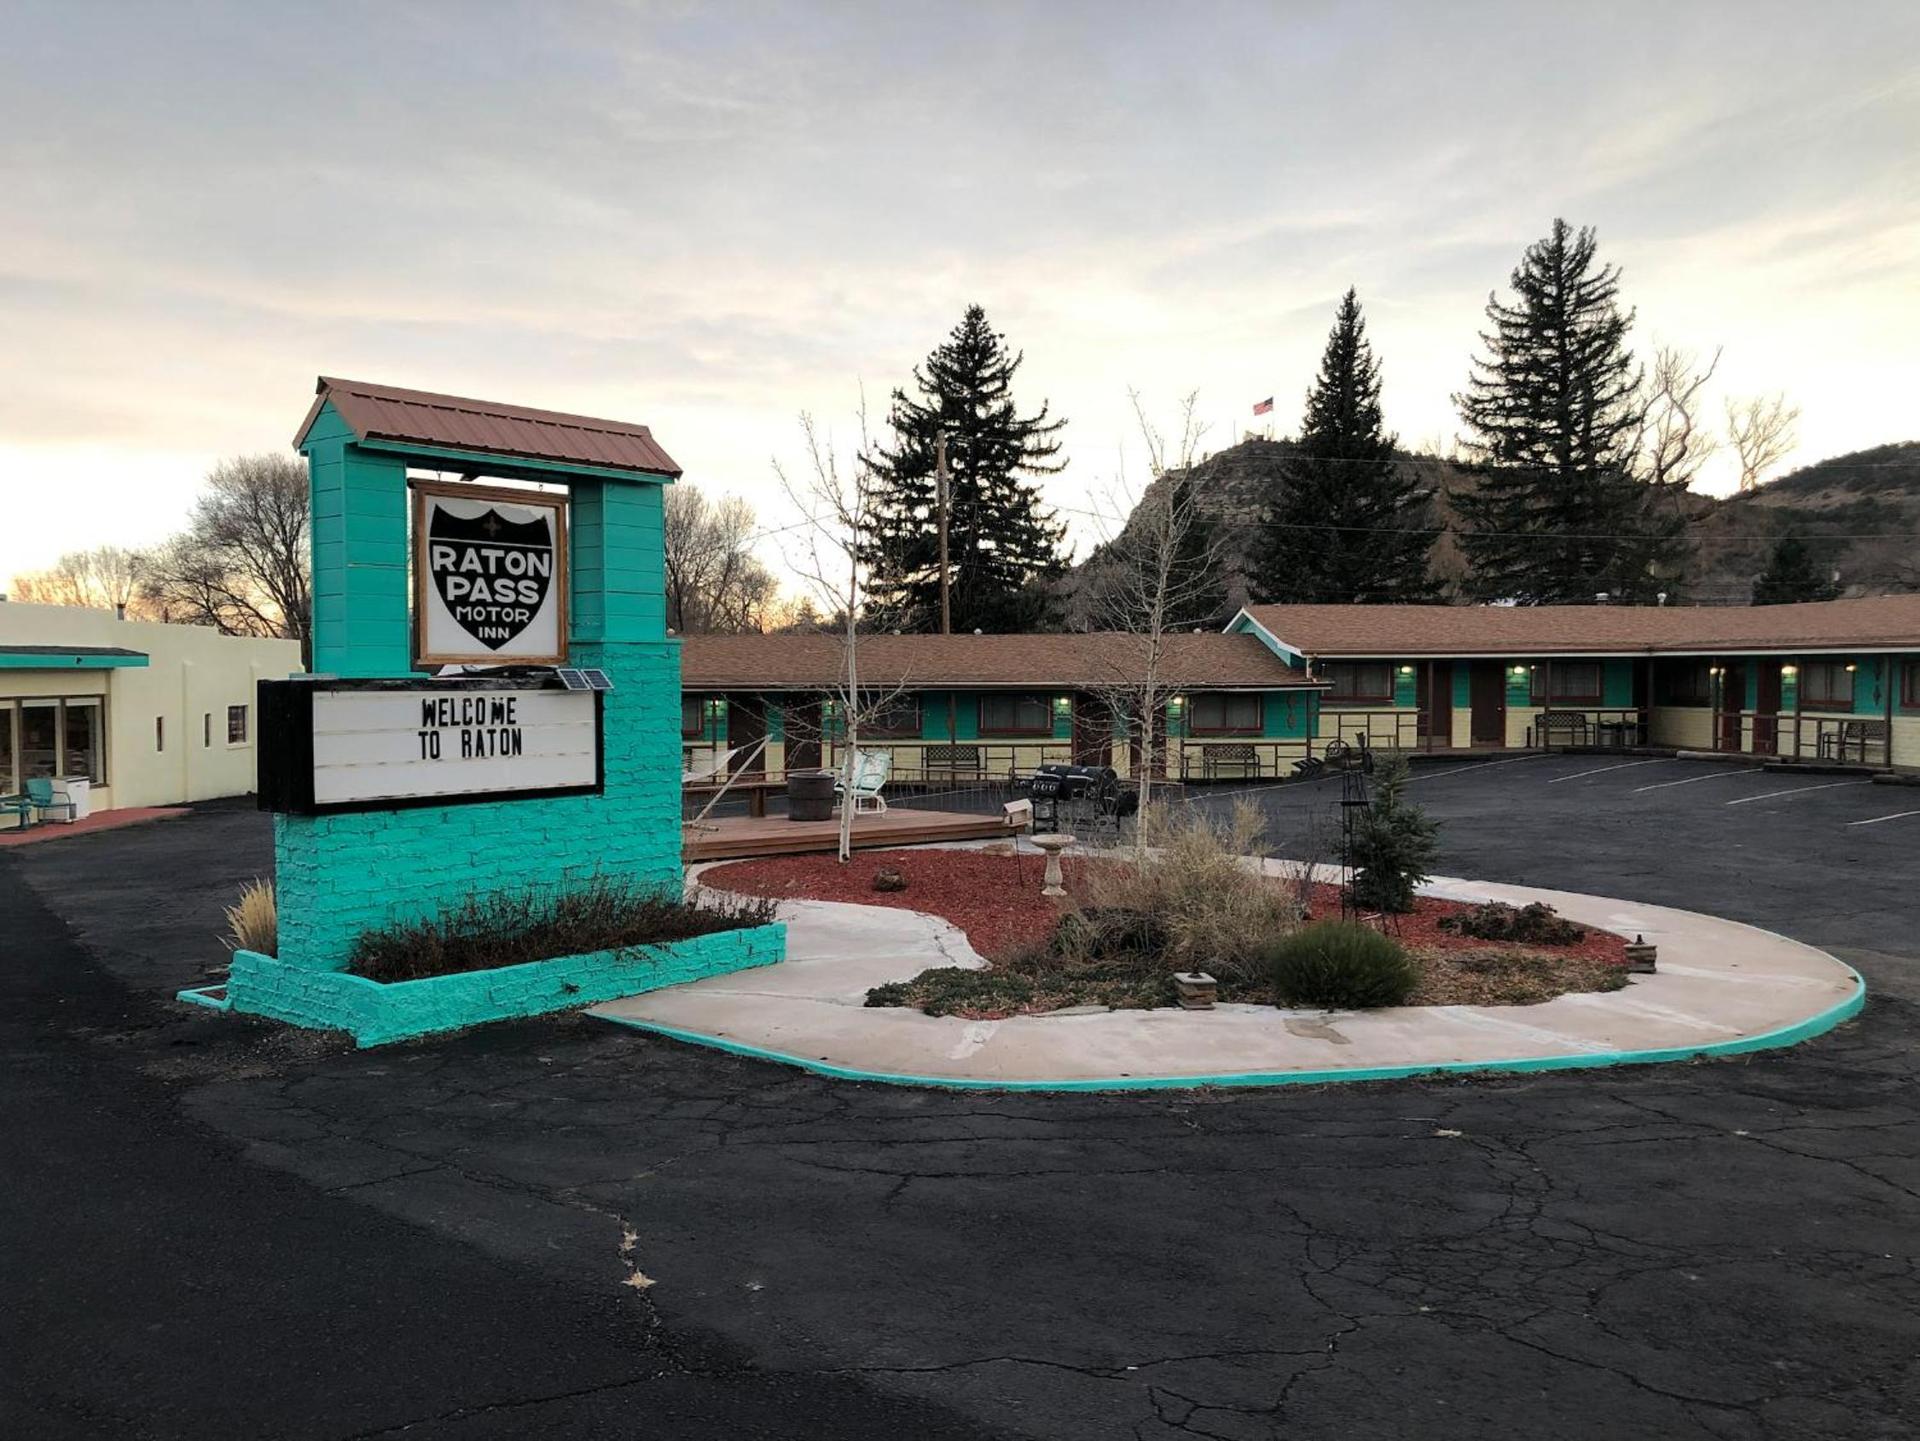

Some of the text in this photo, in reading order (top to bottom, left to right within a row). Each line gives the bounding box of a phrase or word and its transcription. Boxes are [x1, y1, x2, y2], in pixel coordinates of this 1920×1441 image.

[432, 545, 550, 577] RATON
[446, 576, 540, 604] PASS
[456, 606, 530, 623] MOTOR
[478, 626, 510, 639] INN
[421, 697, 517, 728] WELCOME
[418, 728, 522, 760] TO RATON
